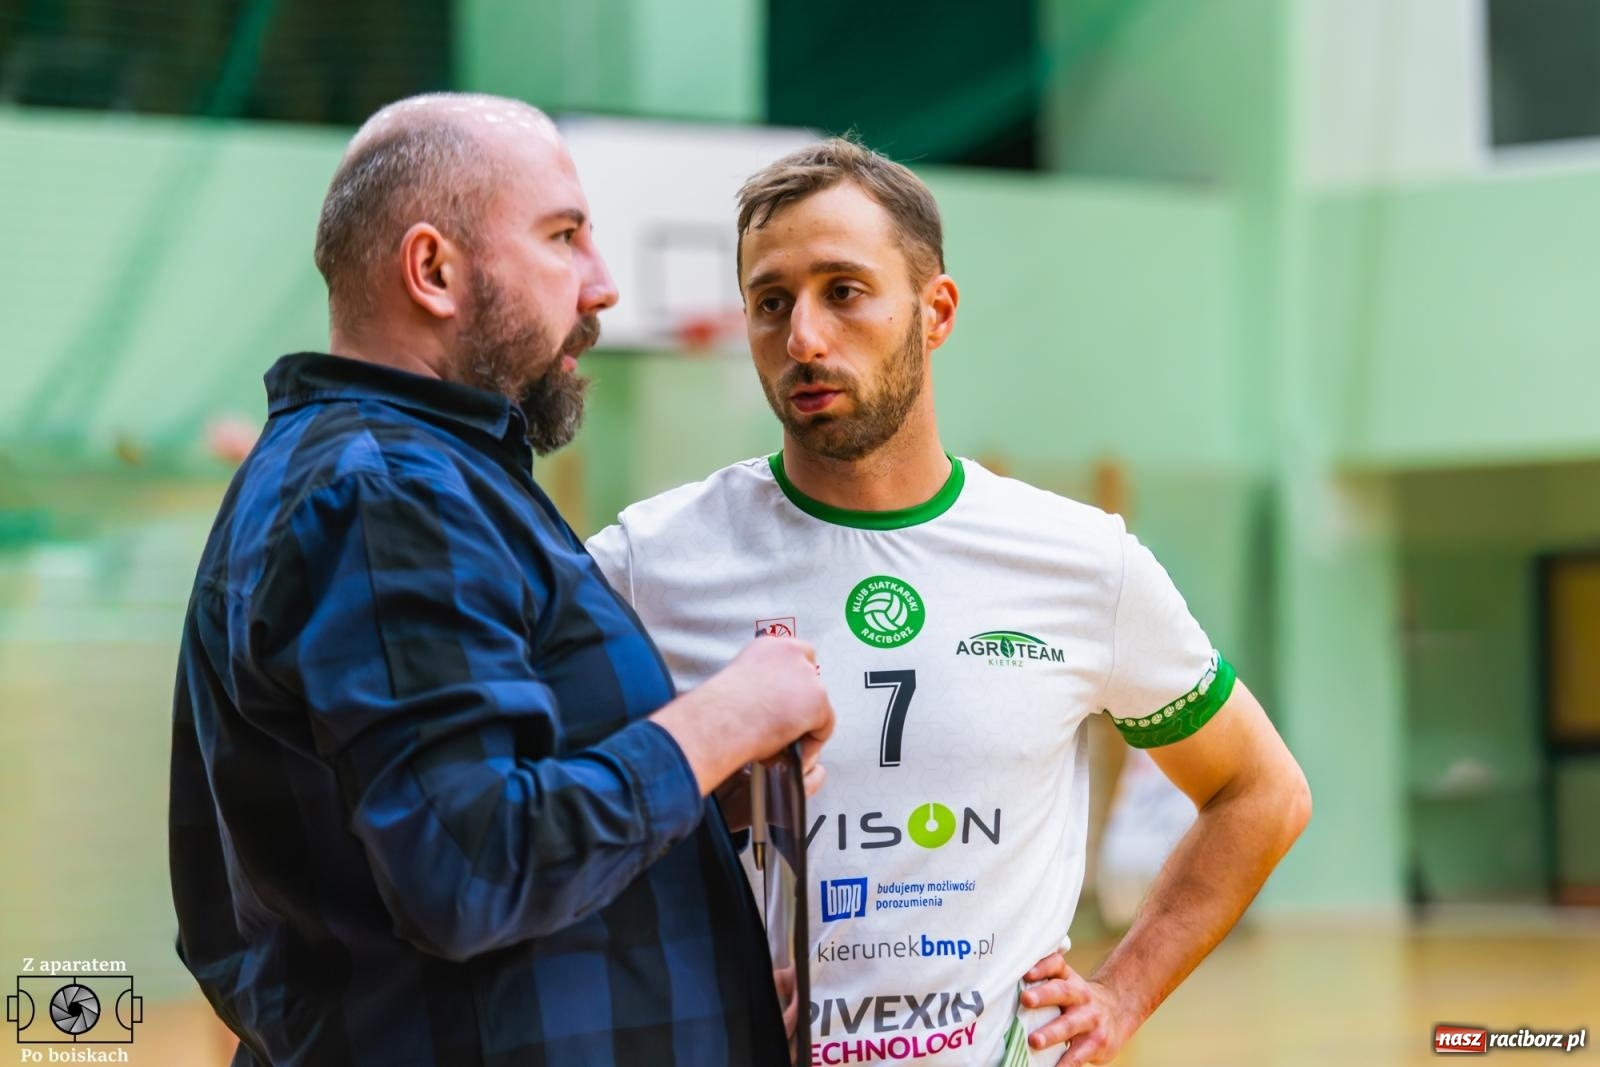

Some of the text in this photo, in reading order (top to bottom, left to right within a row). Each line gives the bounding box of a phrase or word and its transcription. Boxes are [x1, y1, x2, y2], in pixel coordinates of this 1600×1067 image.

[852, 581, 919, 612] KLUB SIATKARSKI
[861, 626, 914, 643] RACIBÓRZ
[988, 659, 1024, 668] KIETRZ
[864, 669, 917, 767] 7
[826, 879, 862, 918] bmp
[877, 880, 976, 895] budujemy możliwości
[876, 896, 943, 911] porozumienia
[817, 933, 995, 963] kierunekbmp.pl
[811, 1022, 977, 1067] ECHNOLOGY
